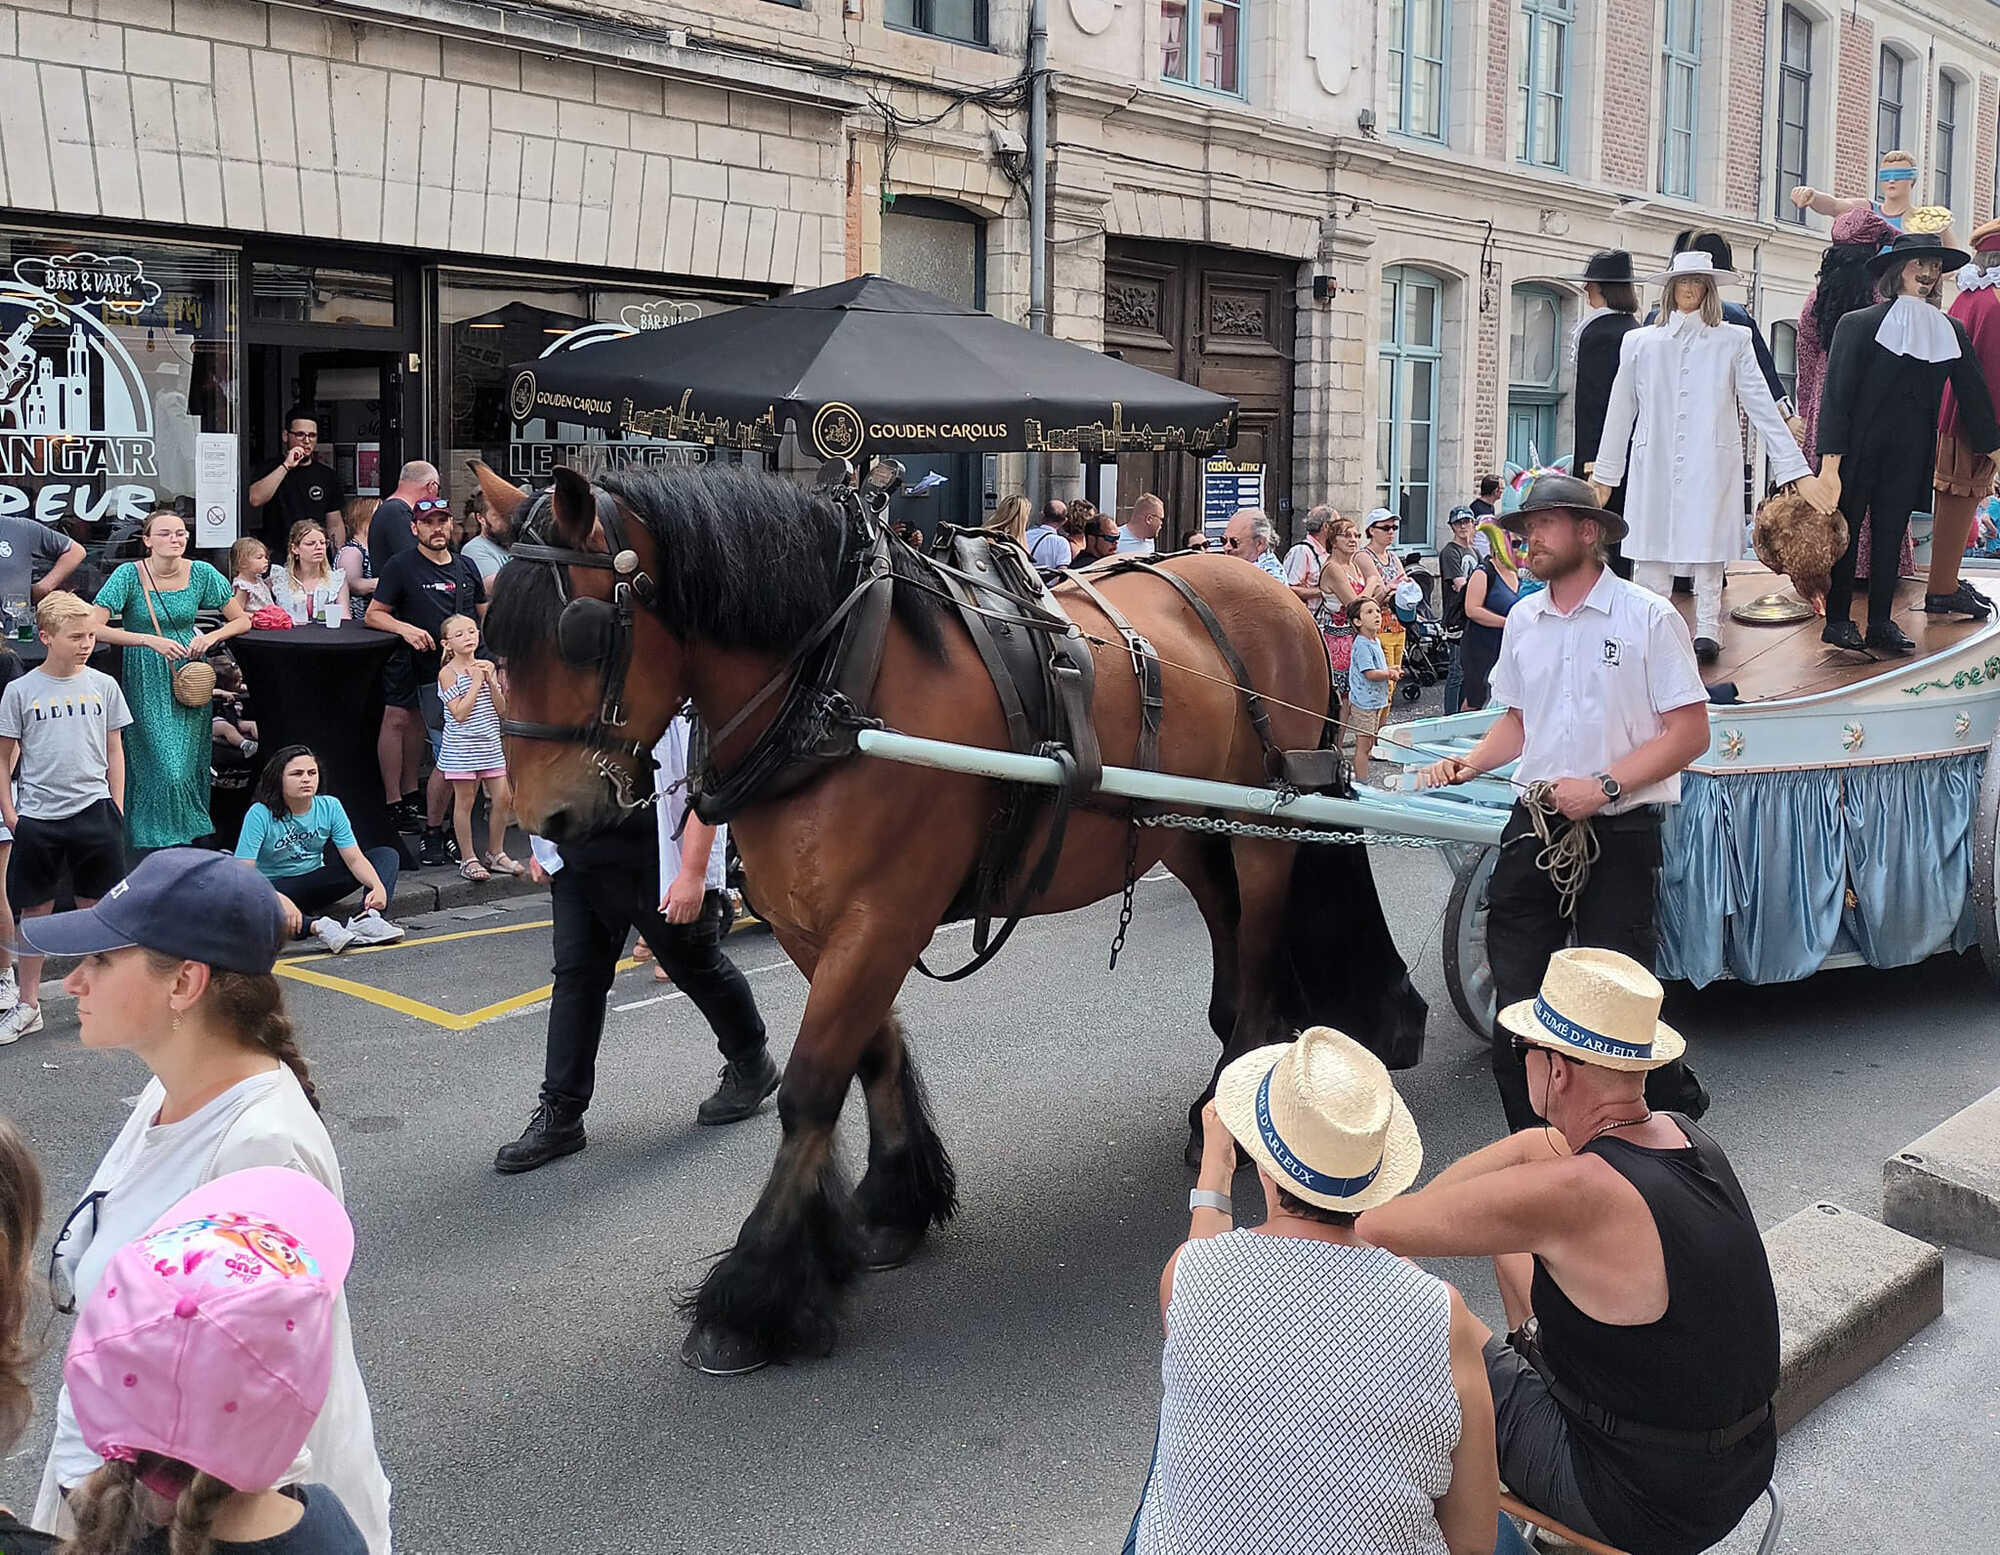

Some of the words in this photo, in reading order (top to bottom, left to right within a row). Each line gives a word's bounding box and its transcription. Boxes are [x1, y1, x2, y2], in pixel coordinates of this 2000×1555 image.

[46, 269, 78, 291] BAR
[81, 271, 92, 292] &
[94, 273, 133, 295] VAPE
[537, 392, 572, 408] GOUDEN
[573, 397, 612, 415] CAROLUS
[869, 424, 937, 439] GOUDEN
[940, 424, 1008, 442] CAROLUS
[510, 444, 552, 477] LE
[1542, 1011, 1569, 1036] FUMÉ
[1260, 1114, 1315, 1185] D'ARLEUX
